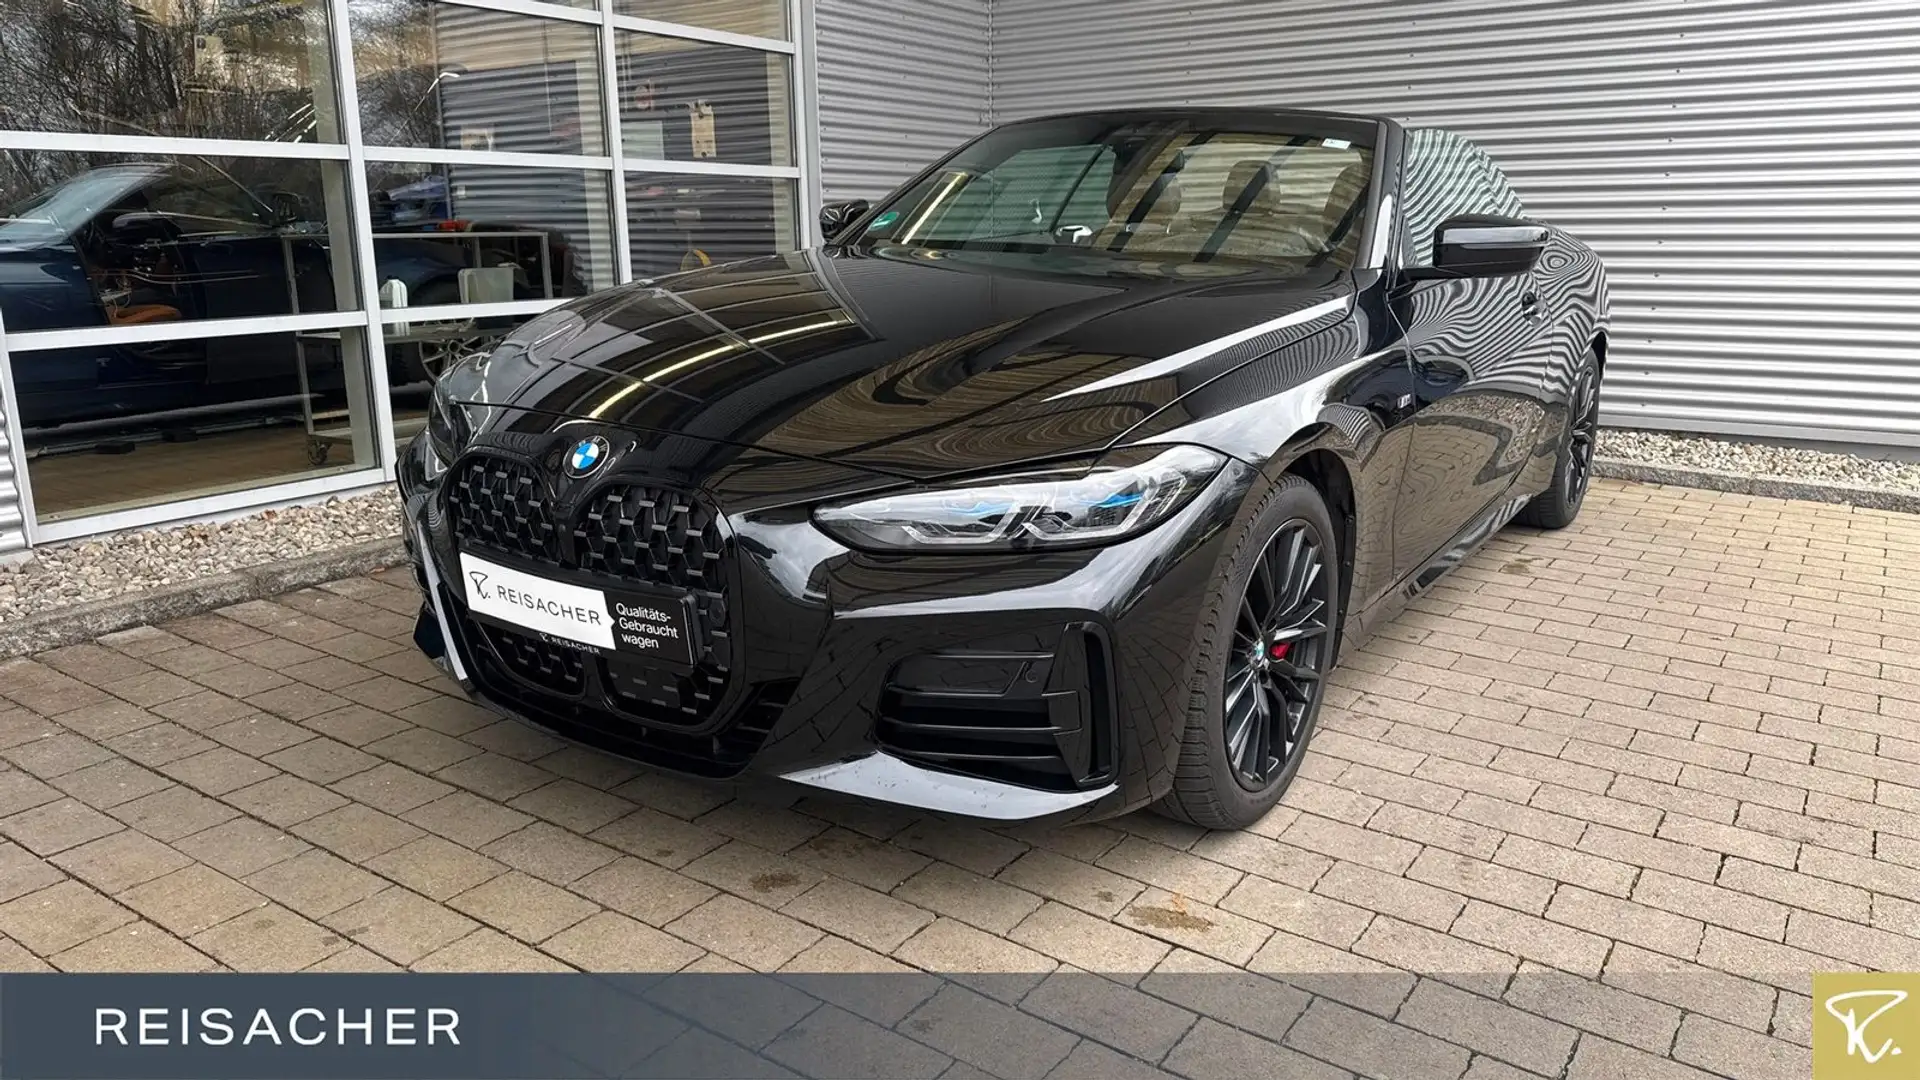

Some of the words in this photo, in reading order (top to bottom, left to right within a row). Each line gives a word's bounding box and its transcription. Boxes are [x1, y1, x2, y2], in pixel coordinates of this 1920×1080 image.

[497, 585, 601, 625] REISACHER
[615, 602, 672, 622] Qualitäts-
[619, 616, 679, 639] Gebraucht
[621, 633, 659, 649] wagen
